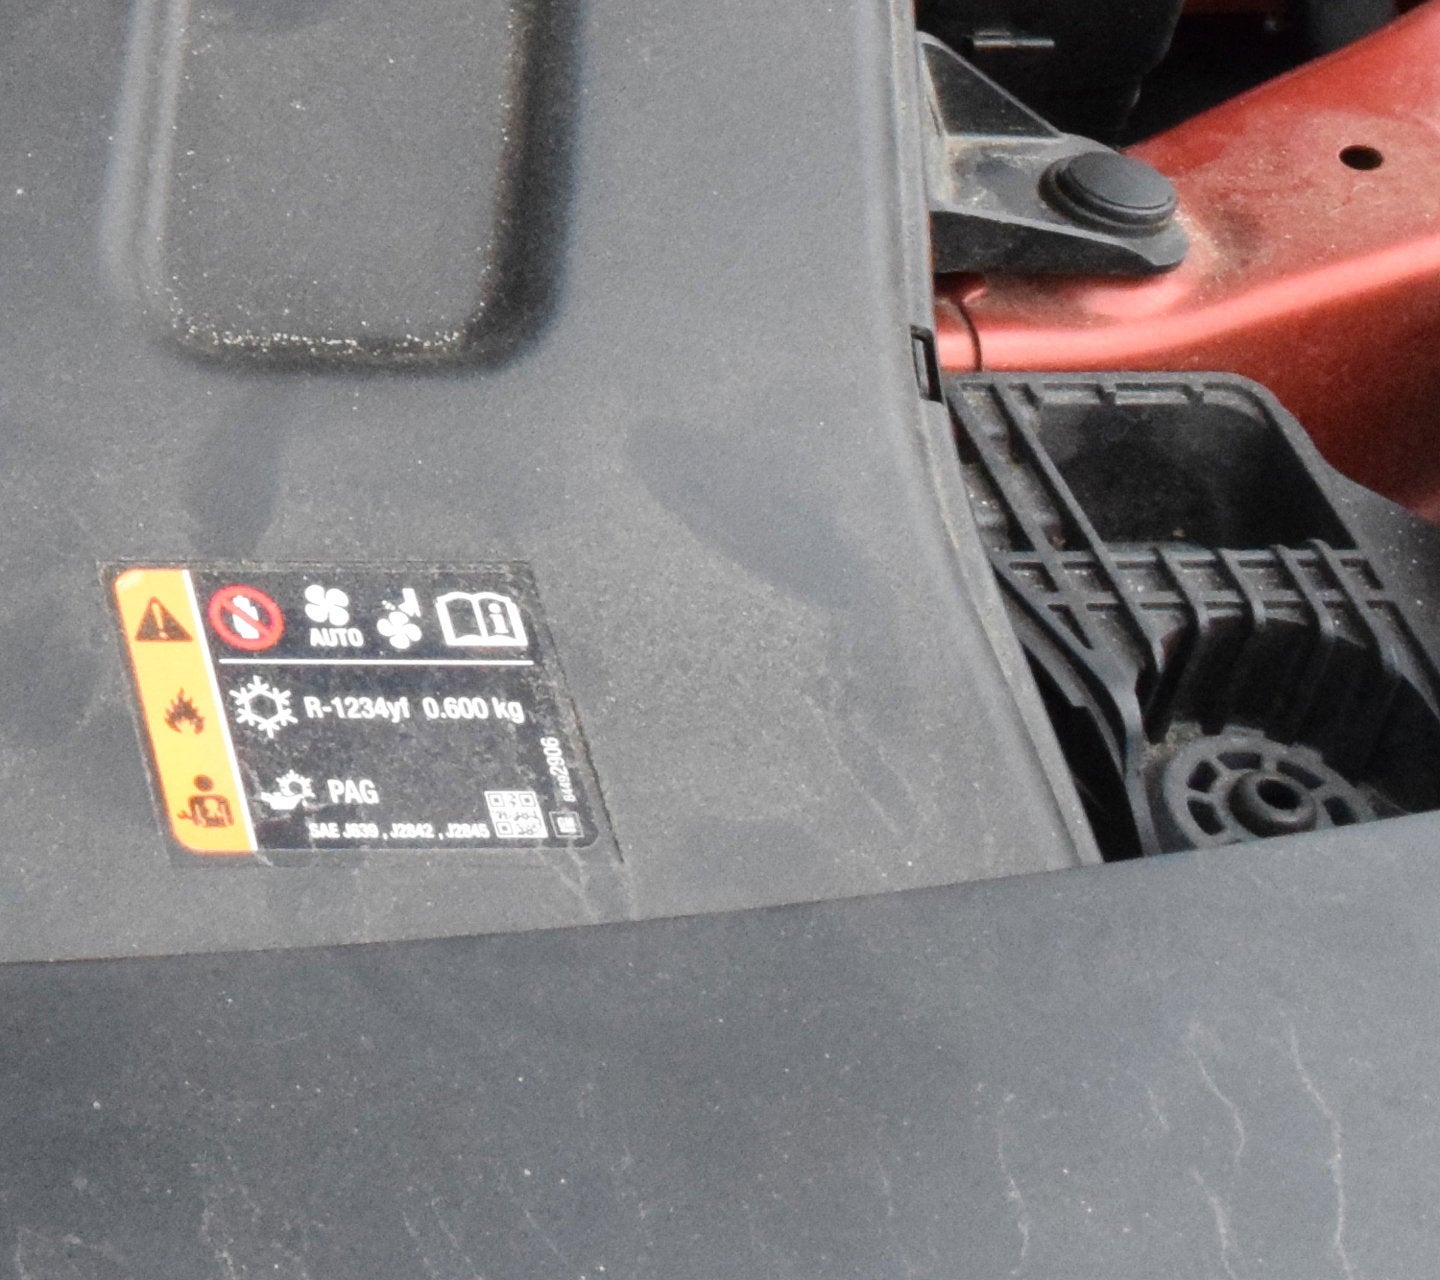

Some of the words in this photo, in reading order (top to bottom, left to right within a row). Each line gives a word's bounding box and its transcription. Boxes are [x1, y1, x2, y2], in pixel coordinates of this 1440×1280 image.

[309, 627, 364, 648] AUTO
[304, 695, 411, 722] R-1234yf
[423, 696, 489, 720] 0.600
[492, 696, 524, 724] kg
[327, 779, 379, 805] PAG
[308, 823, 340, 838] SAE
